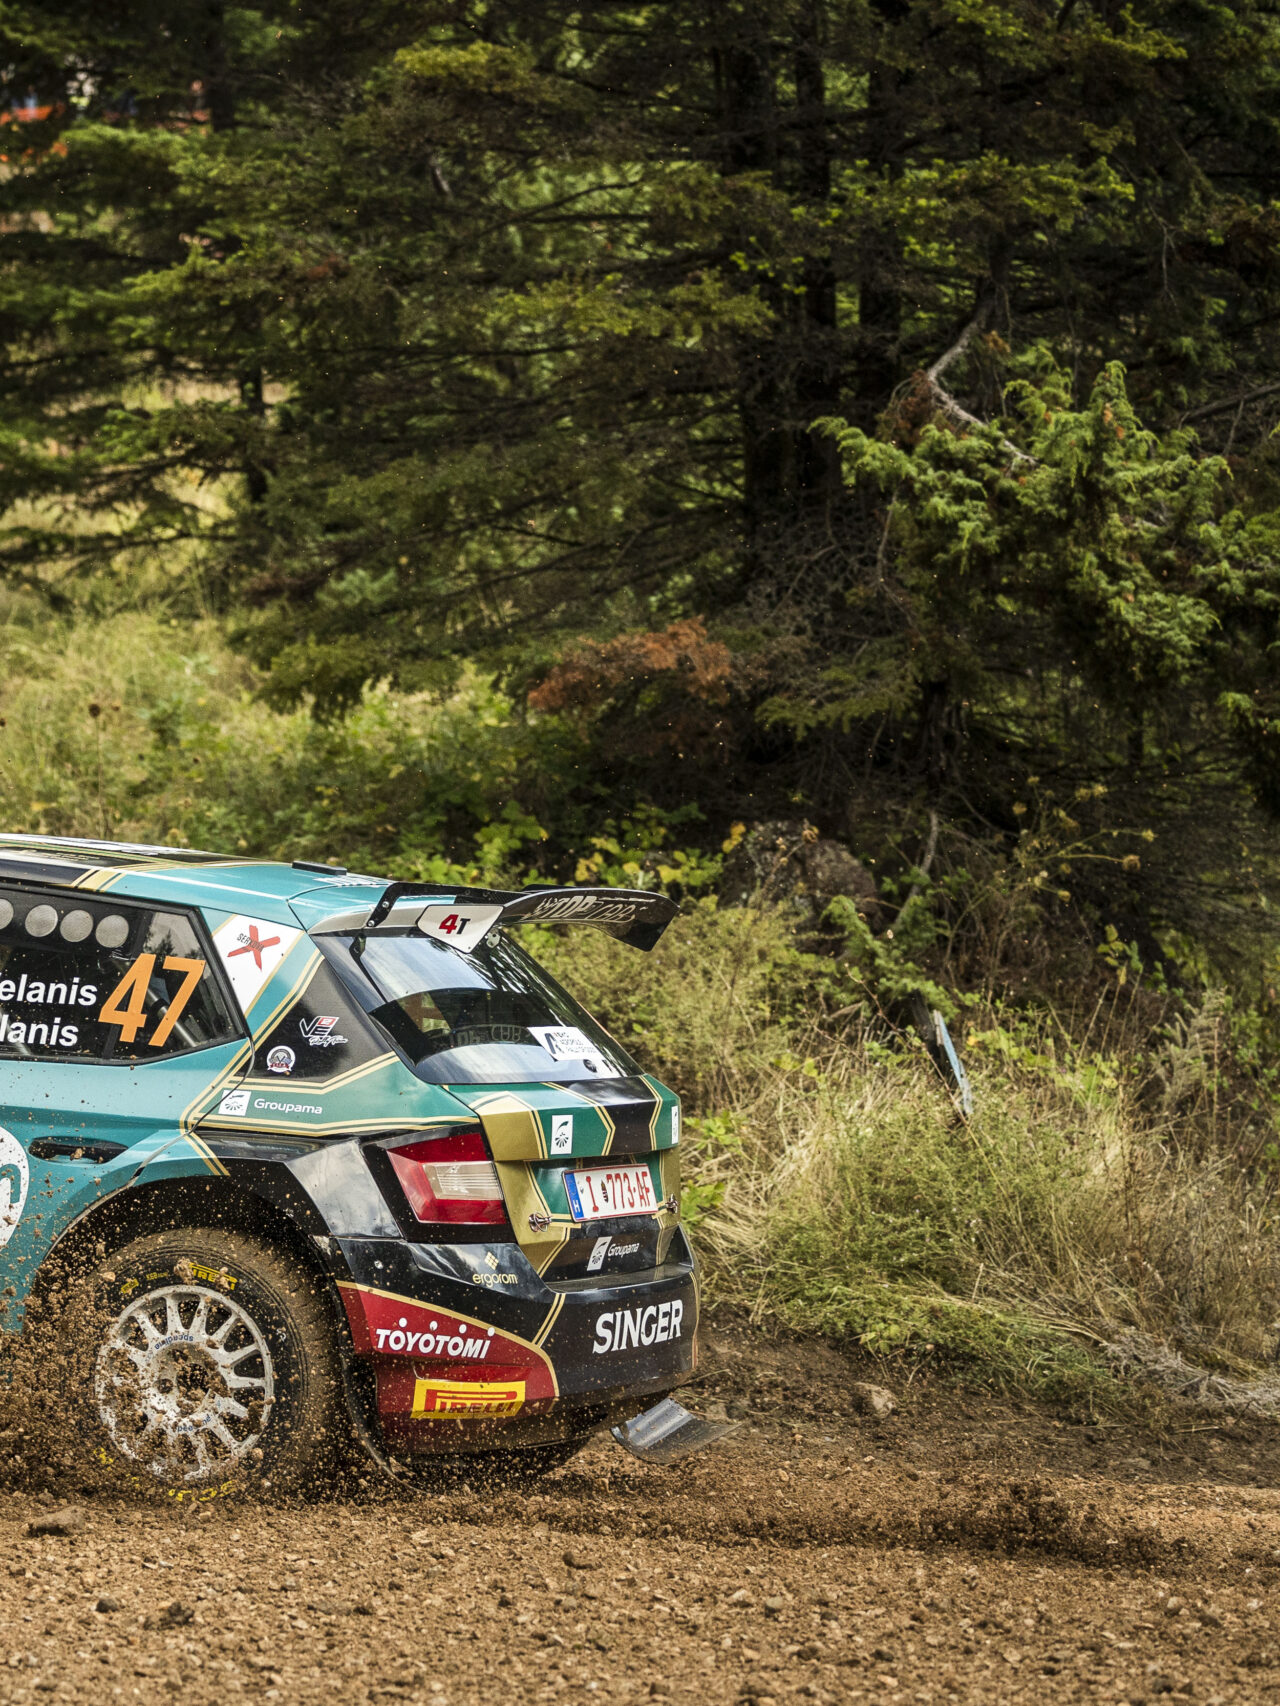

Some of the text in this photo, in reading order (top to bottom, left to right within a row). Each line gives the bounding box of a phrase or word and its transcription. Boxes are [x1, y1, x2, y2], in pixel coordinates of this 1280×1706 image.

[439, 914, 471, 935] 4T
[97, 952, 206, 1047] 47
[253, 1098, 323, 1115] Groupama
[375, 1318, 493, 1360] TOYOTOMI
[592, 1299, 684, 1355] SINGER
[423, 1388, 518, 1415] PIRELLI
